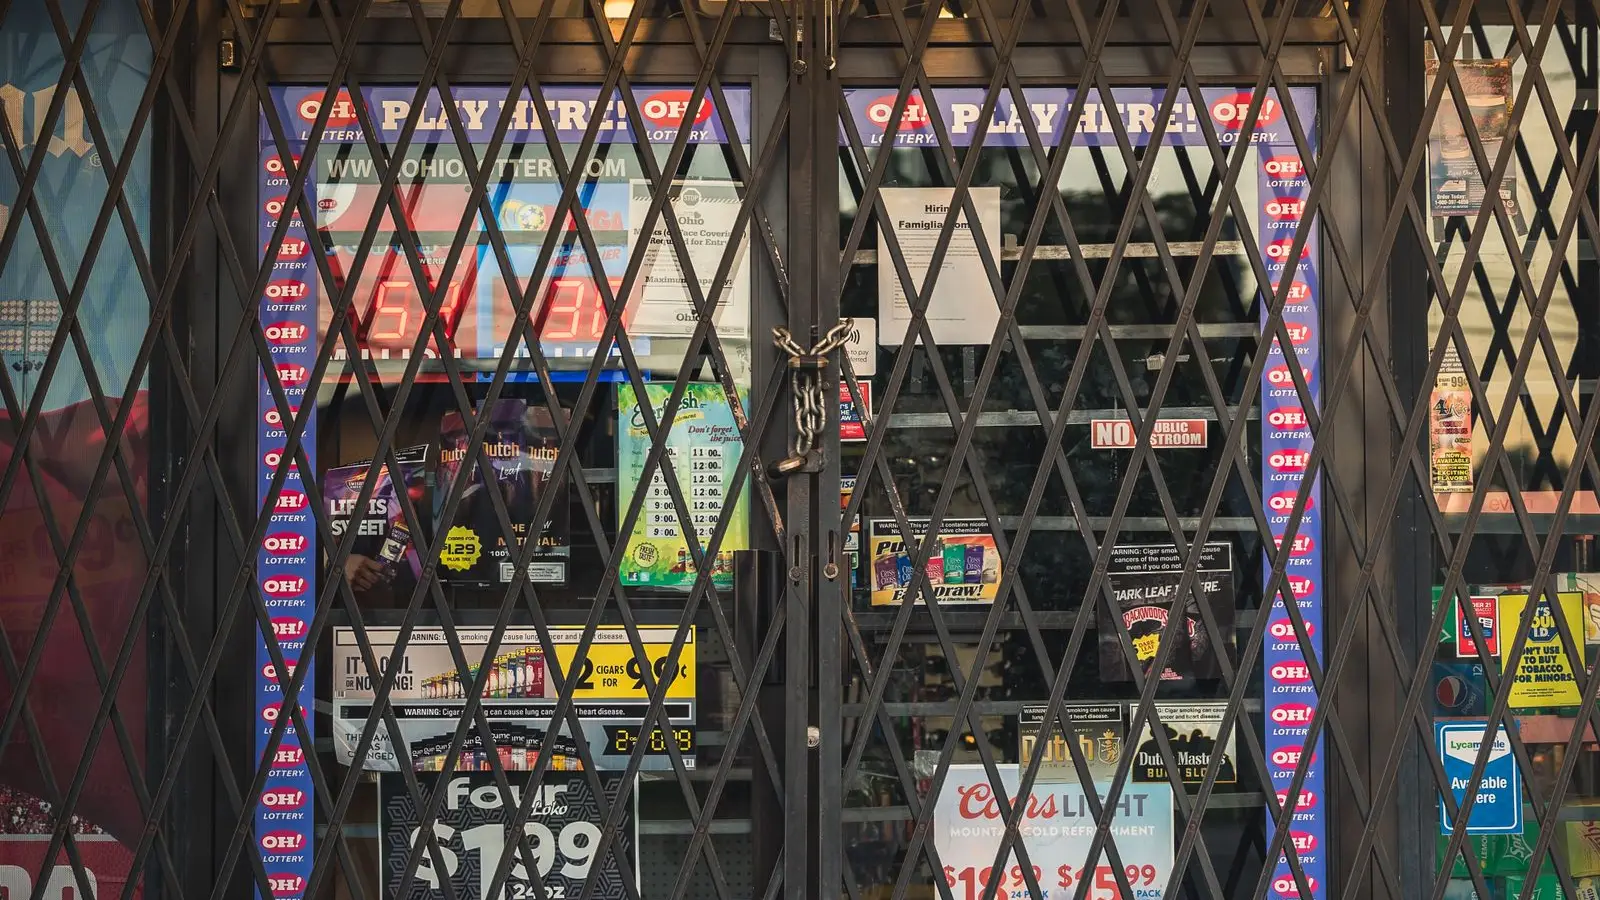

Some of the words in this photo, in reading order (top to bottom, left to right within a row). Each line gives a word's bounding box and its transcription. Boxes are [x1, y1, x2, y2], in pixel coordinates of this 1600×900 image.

[678, 216, 704, 226] Ohio
[266, 283, 306, 298] OH!
[266, 325, 306, 340] OH!
[1096, 422, 1130, 446] NO
[1154, 422, 1189, 433] UBLIC
[369, 498, 388, 515] IS
[264, 535, 305, 550] OH!
[264, 577, 304, 593] OH!
[1145, 585, 1172, 598] LEAF
[1543, 645, 1560, 654] USE
[1524, 656, 1537, 664] TO
[1539, 655, 1557, 664] BUY
[596, 665, 625, 675] CIGARS
[1520, 664, 1563, 674] TOBACCO
[602, 678, 618, 687] FOR
[404, 708, 442, 716] WARNING:
[442, 708, 459, 717] Cigar
[525, 708, 539, 717] lung
[579, 708, 596, 716] heart
[262, 790, 302, 806] OH!
[1474, 793, 1497, 804] ere
[530, 801, 568, 816] Loko
[262, 833, 302, 849] OH!
[1011, 890, 1022, 899] 24
[1136, 889, 1161, 898] PACK
